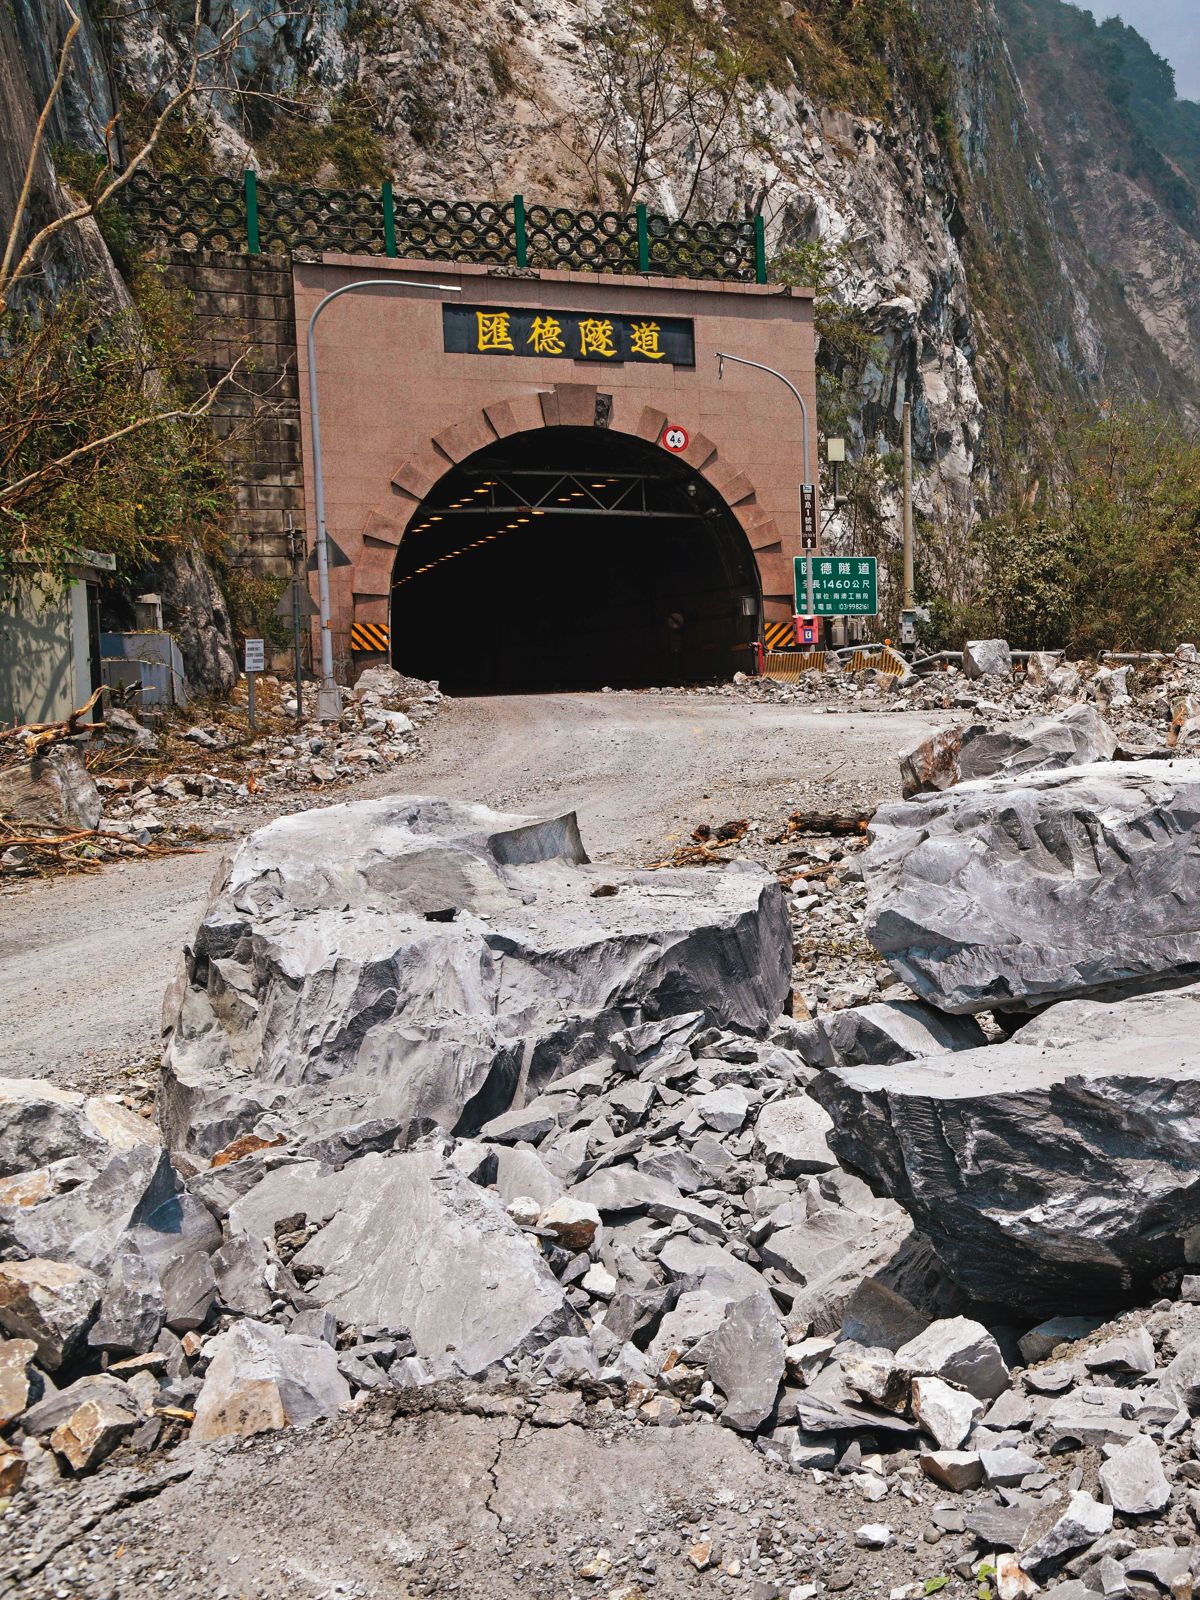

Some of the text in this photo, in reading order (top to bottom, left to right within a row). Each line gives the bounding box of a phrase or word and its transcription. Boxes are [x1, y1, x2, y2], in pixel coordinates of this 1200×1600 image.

[476, 311, 666, 359] 匯德隧道
[670, 434, 682, 444] 4.6
